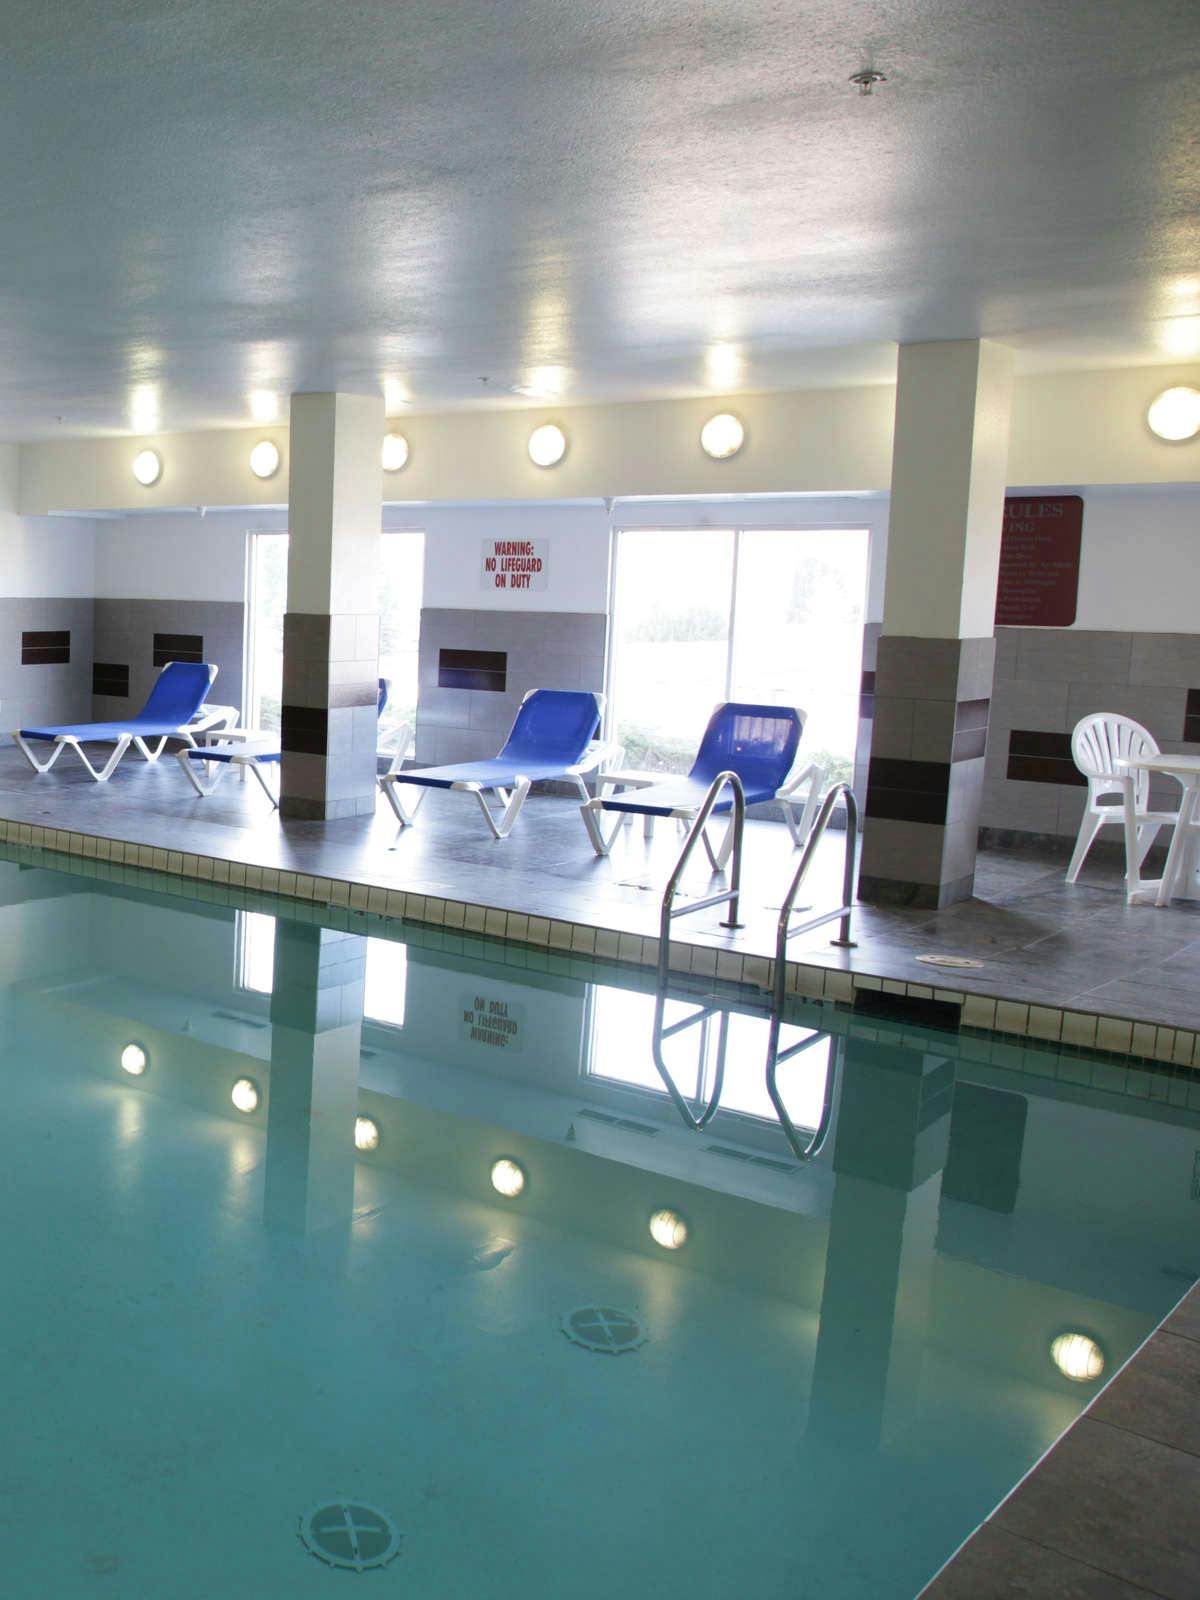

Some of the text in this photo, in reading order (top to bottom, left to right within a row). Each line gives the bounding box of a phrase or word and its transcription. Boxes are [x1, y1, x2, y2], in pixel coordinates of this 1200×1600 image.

[494, 541, 534, 556] WARNING:
[485, 557, 542, 572] NO LIFEGUARD
[495, 574, 531, 588] ON DUTY
